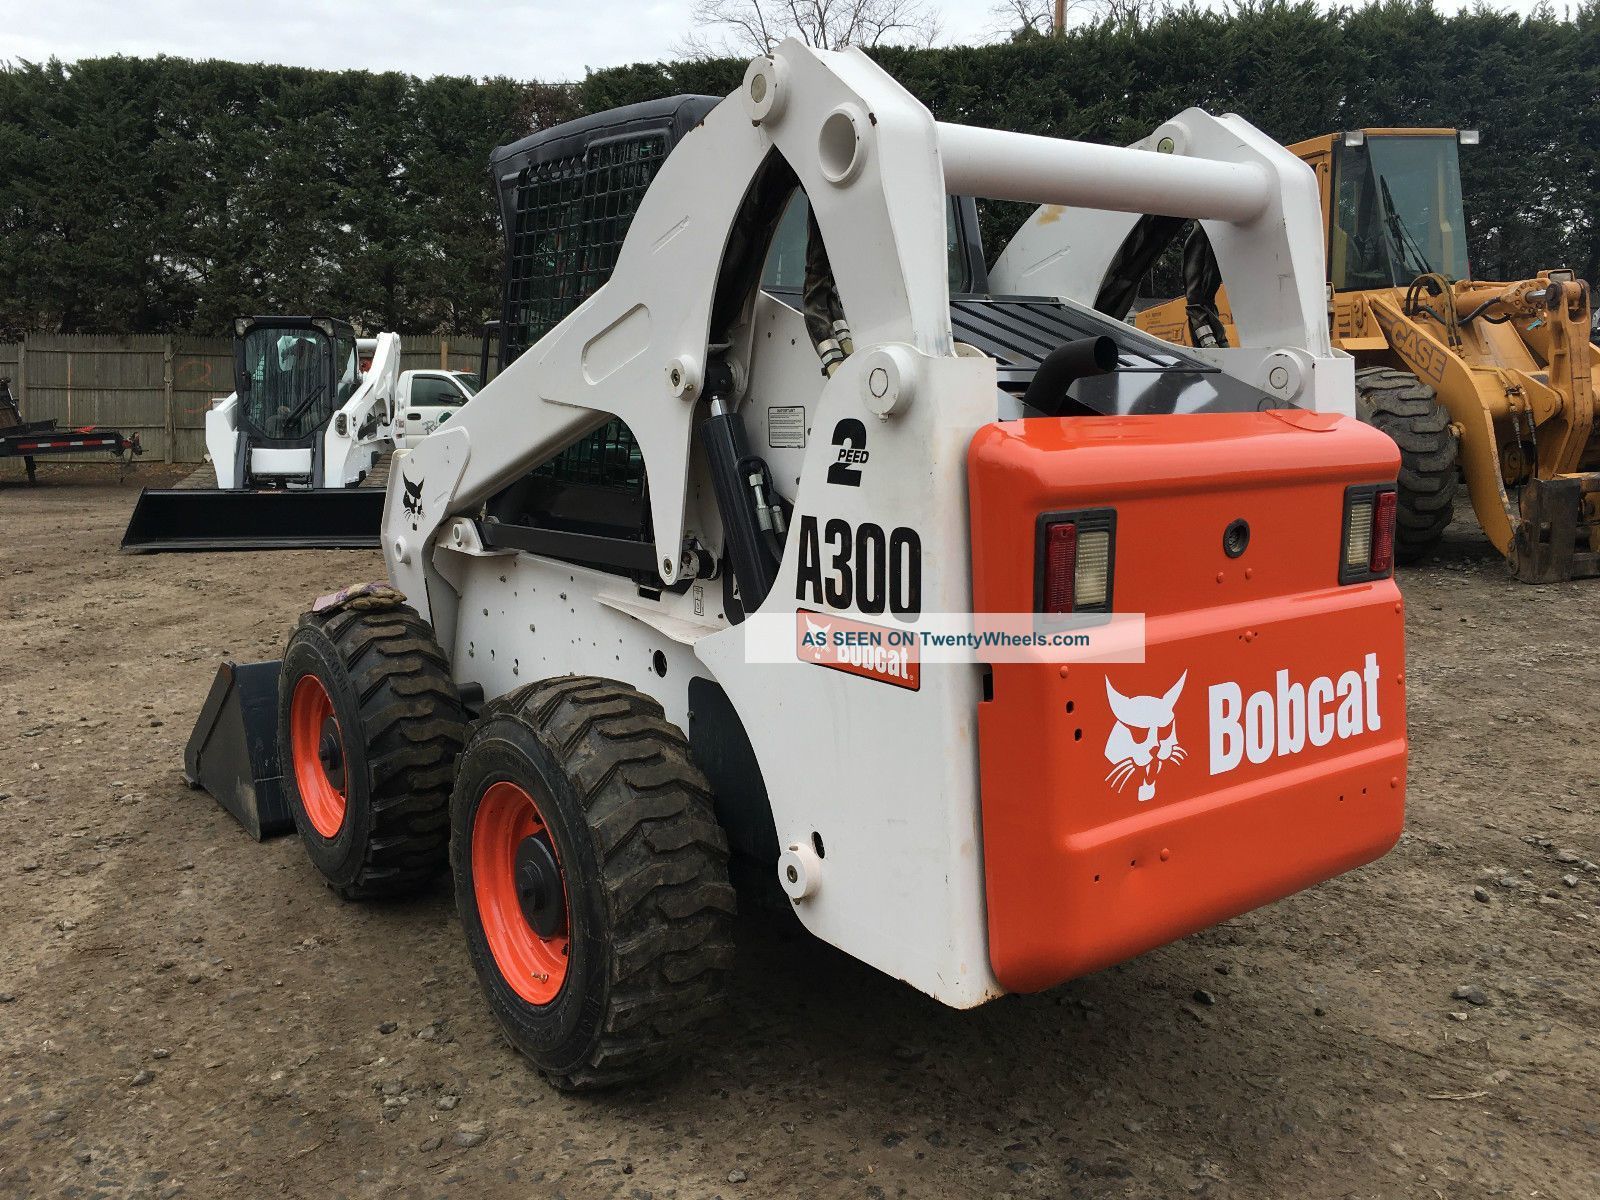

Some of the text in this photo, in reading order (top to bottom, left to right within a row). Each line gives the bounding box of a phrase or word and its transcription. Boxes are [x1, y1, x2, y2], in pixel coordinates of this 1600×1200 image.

[1390, 320, 1448, 383] CASE
[827, 418, 867, 487] 2
[837, 448, 869, 464] PEED
[796, 515, 922, 623] A300
[1208, 652, 1381, 776] Bobcat
